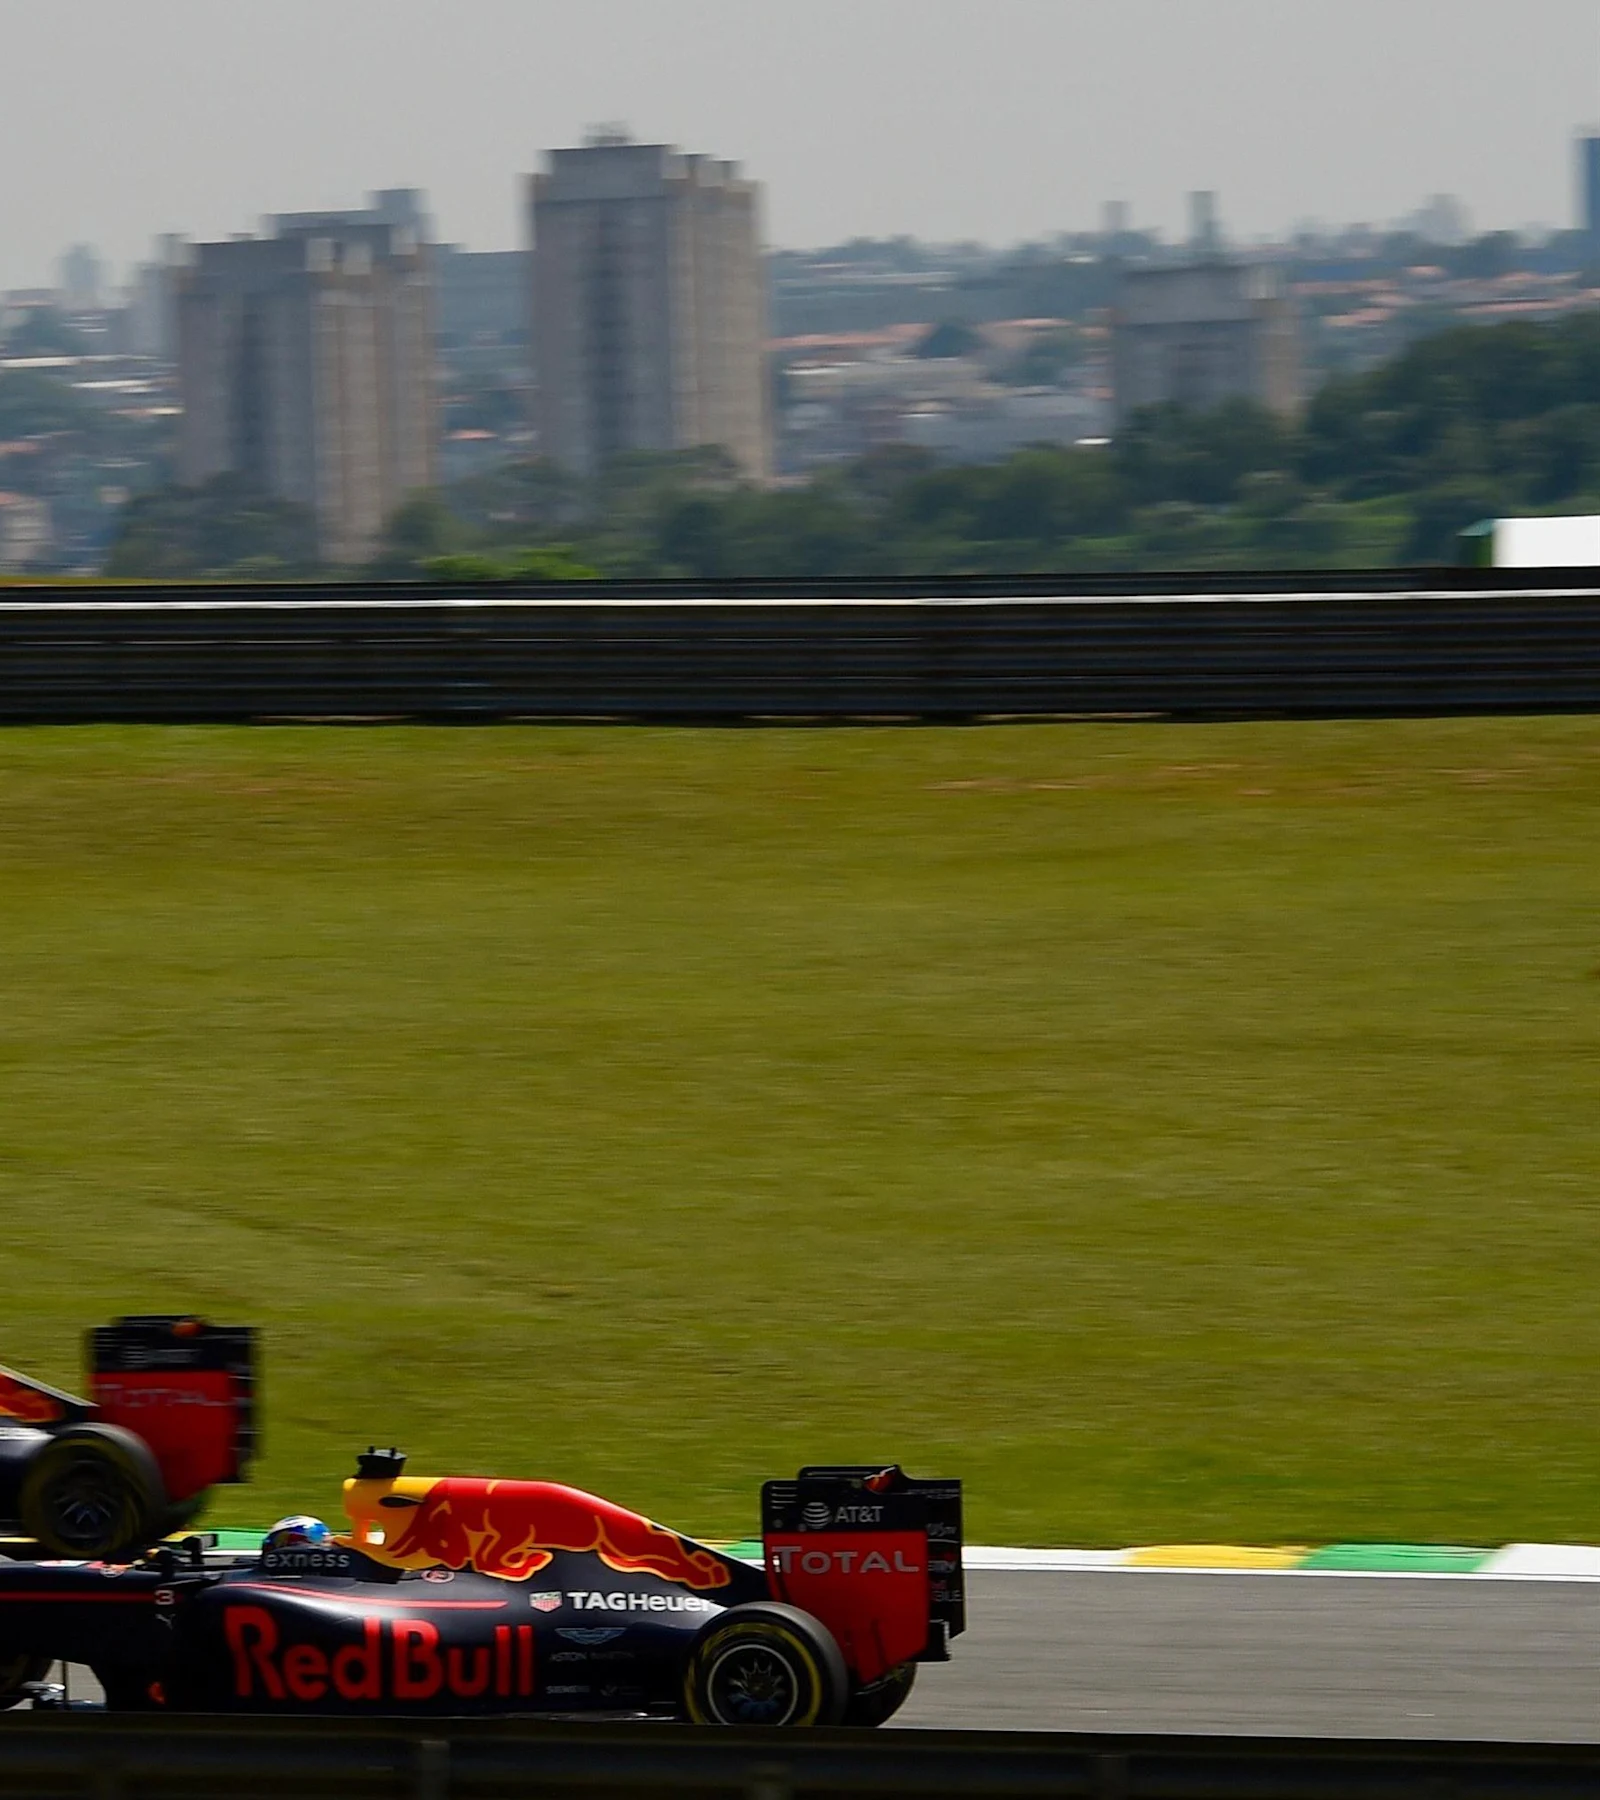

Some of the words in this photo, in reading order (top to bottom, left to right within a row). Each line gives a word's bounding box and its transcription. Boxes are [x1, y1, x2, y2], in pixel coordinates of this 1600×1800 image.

[834, 1506, 884, 1523] AT&T
[264, 1551, 350, 1568] exness
[771, 1546, 919, 1574] TOTAL
[154, 1590, 174, 1606] 3
